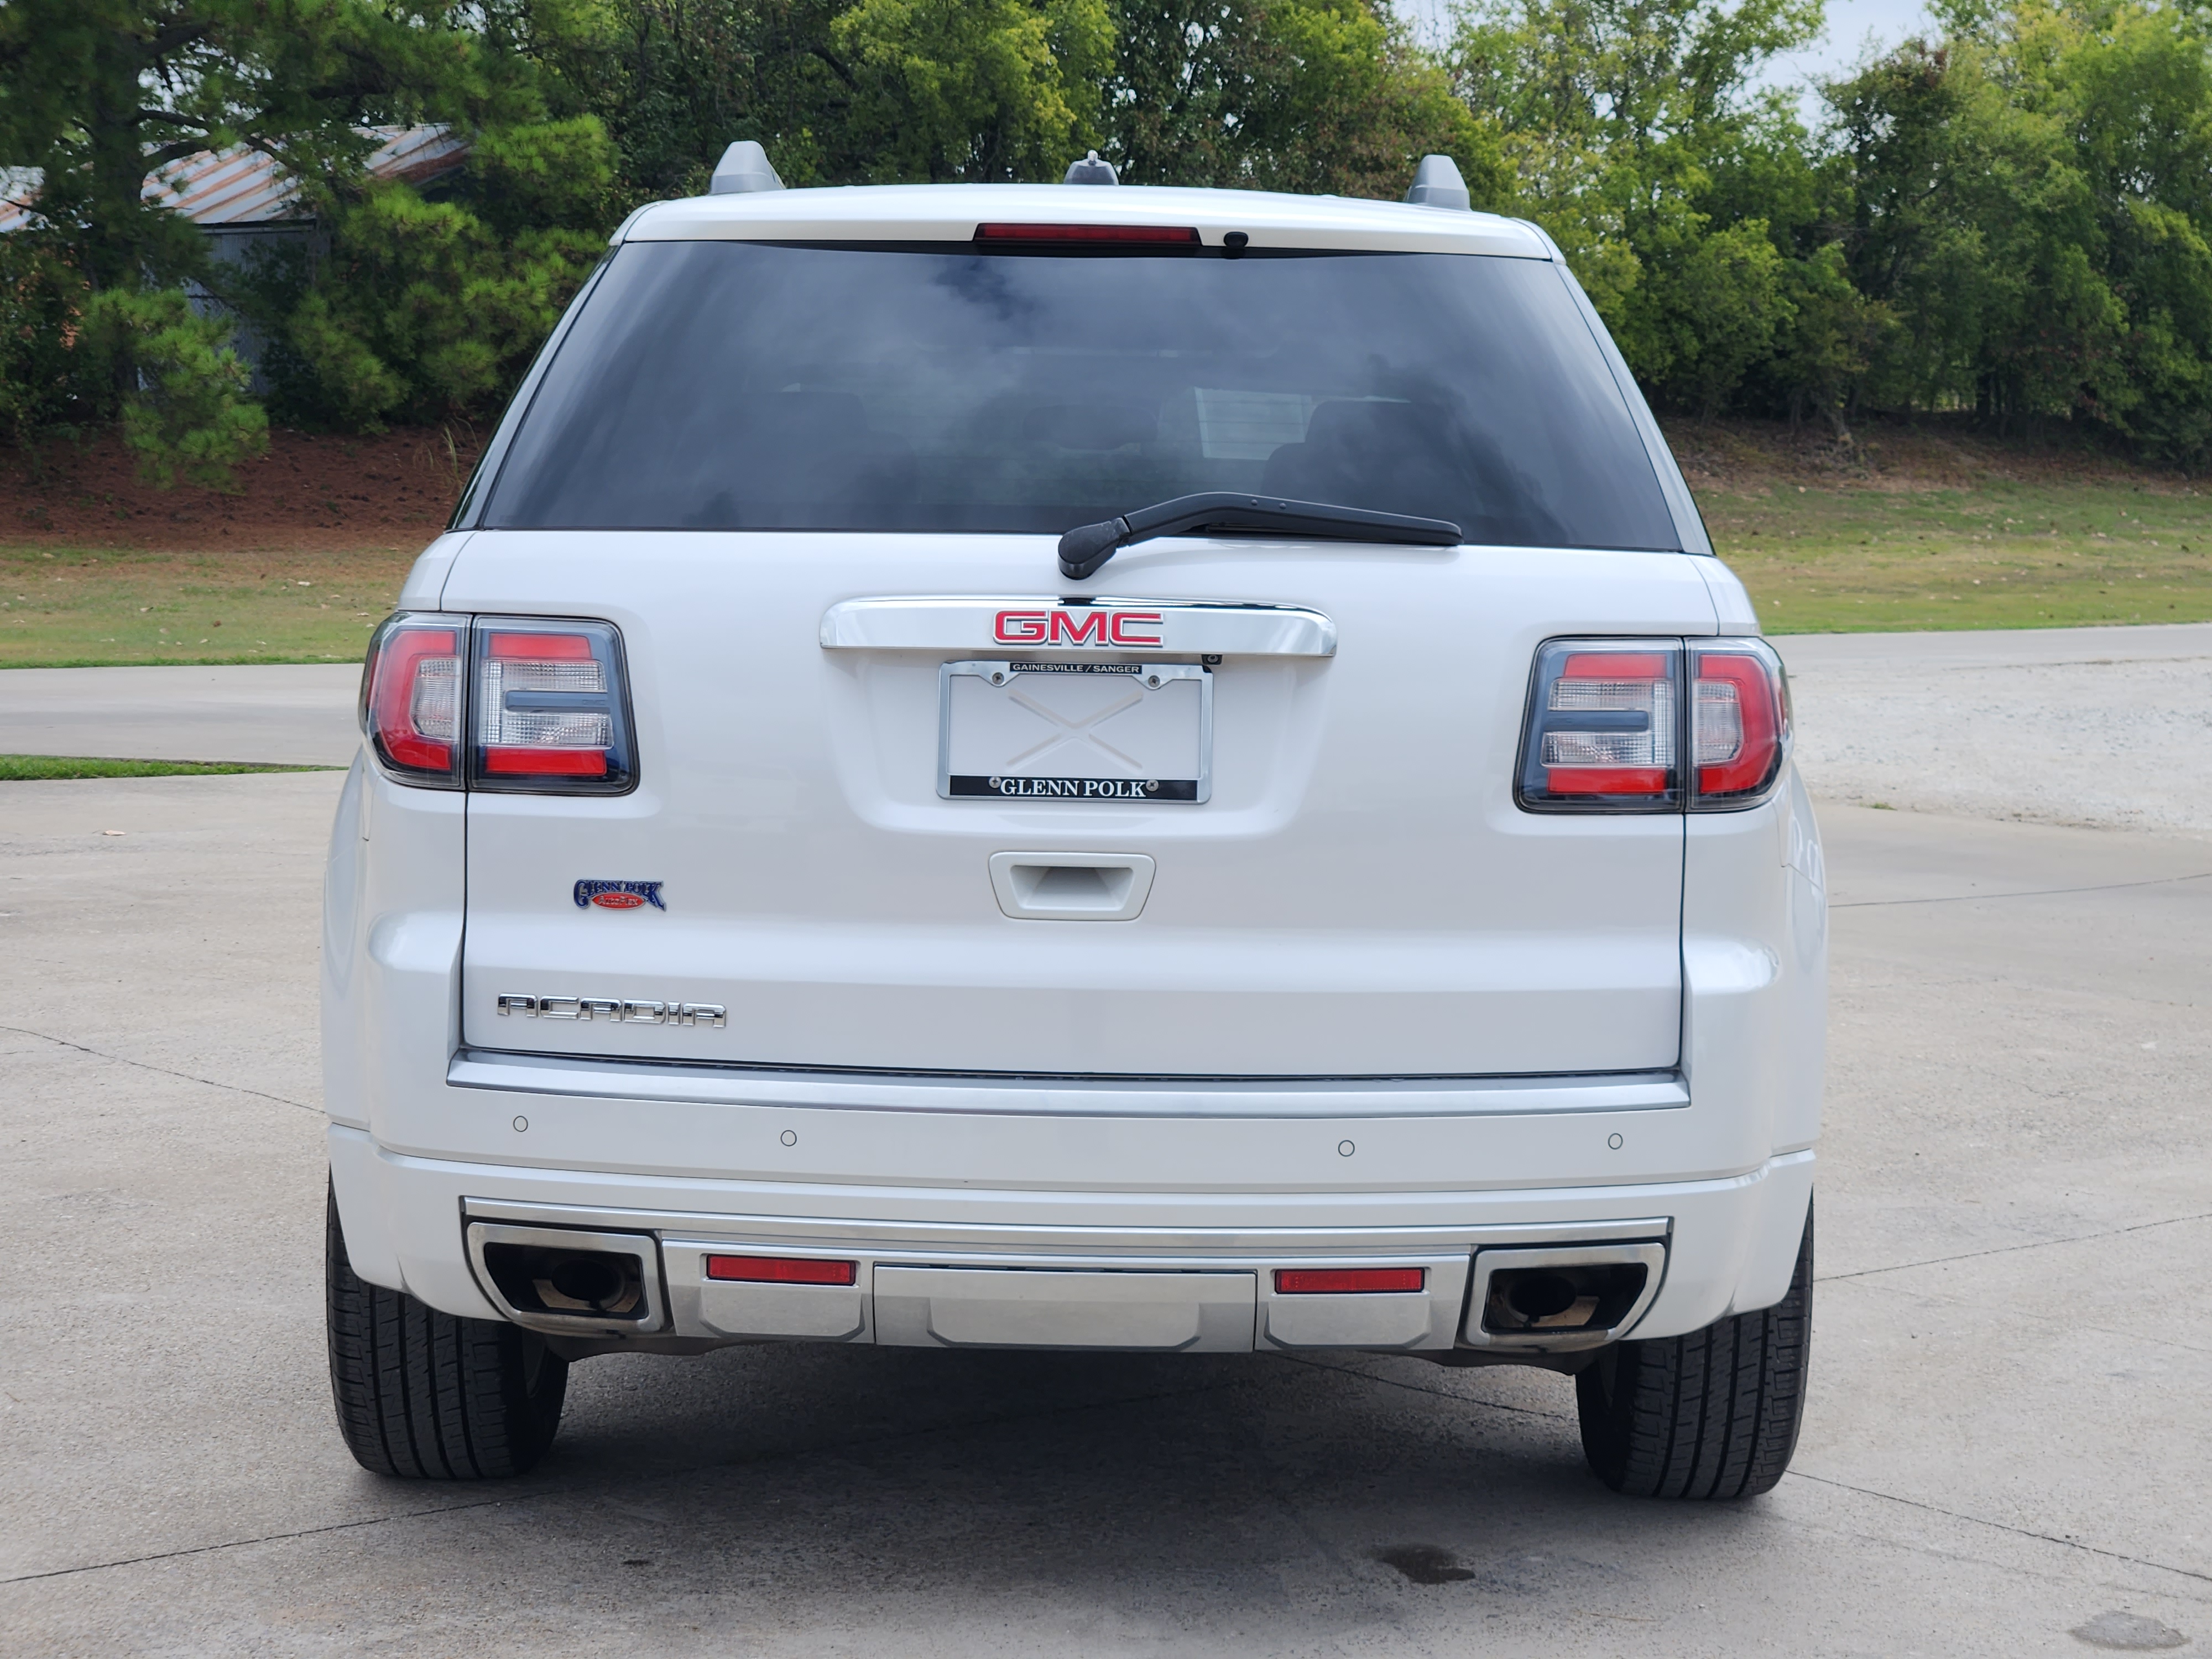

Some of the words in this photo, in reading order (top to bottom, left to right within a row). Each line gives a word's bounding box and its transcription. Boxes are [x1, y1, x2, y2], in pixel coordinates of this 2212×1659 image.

[993, 609, 1164, 647] GMC
[1013, 664, 1084, 672] GAINESVILLE
[1093, 665, 1140, 674] SANGER
[1000, 779, 1080, 796] GLENN
[1083, 780, 1147, 797] POLK
[573, 879, 622, 909] GLENN
[498, 993, 727, 1027] ACADIA
